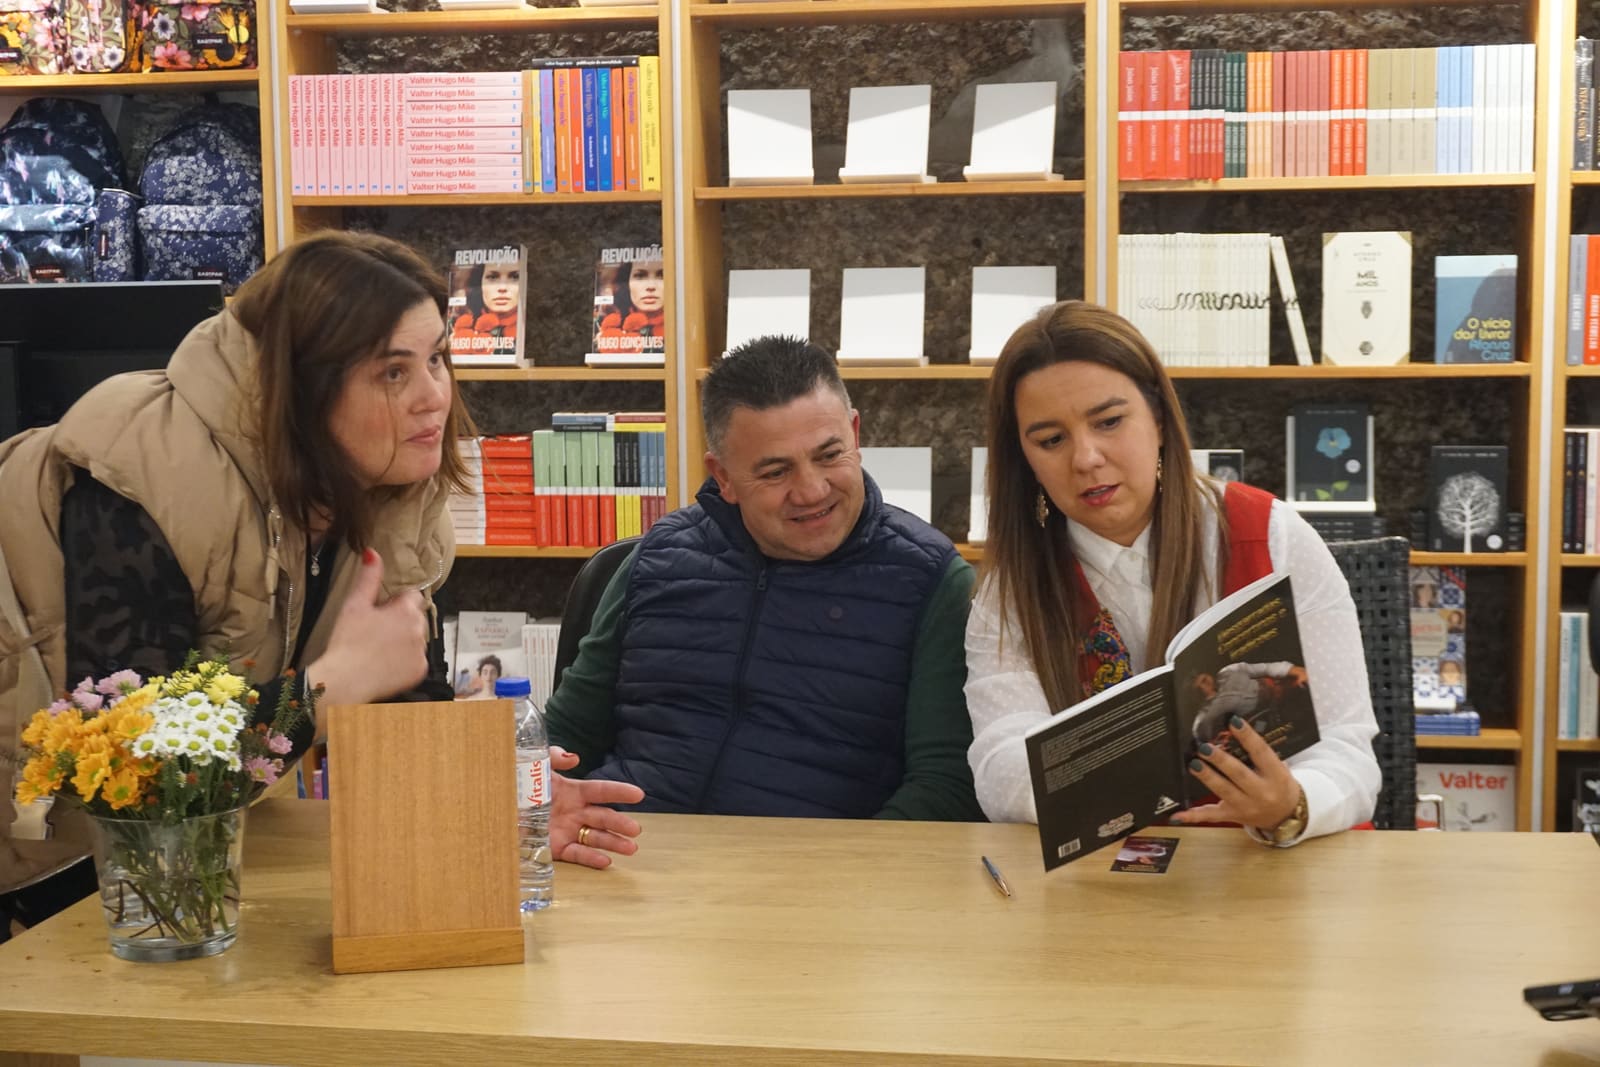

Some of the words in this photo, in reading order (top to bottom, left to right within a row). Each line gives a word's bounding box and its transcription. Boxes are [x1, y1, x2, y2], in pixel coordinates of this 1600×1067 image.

[455, 246, 519, 267] REVOLUÇÃO
[1467, 317, 1479, 329] O
[450, 337, 471, 350] HUGO
[472, 336, 514, 351] GONÇALVES
[598, 336, 618, 349] HUGO
[620, 336, 663, 352] GONÇALVES
[1481, 350, 1511, 360] Cruz
[528, 760, 543, 805] Vitalis
[1440, 771, 1508, 790] Valter
